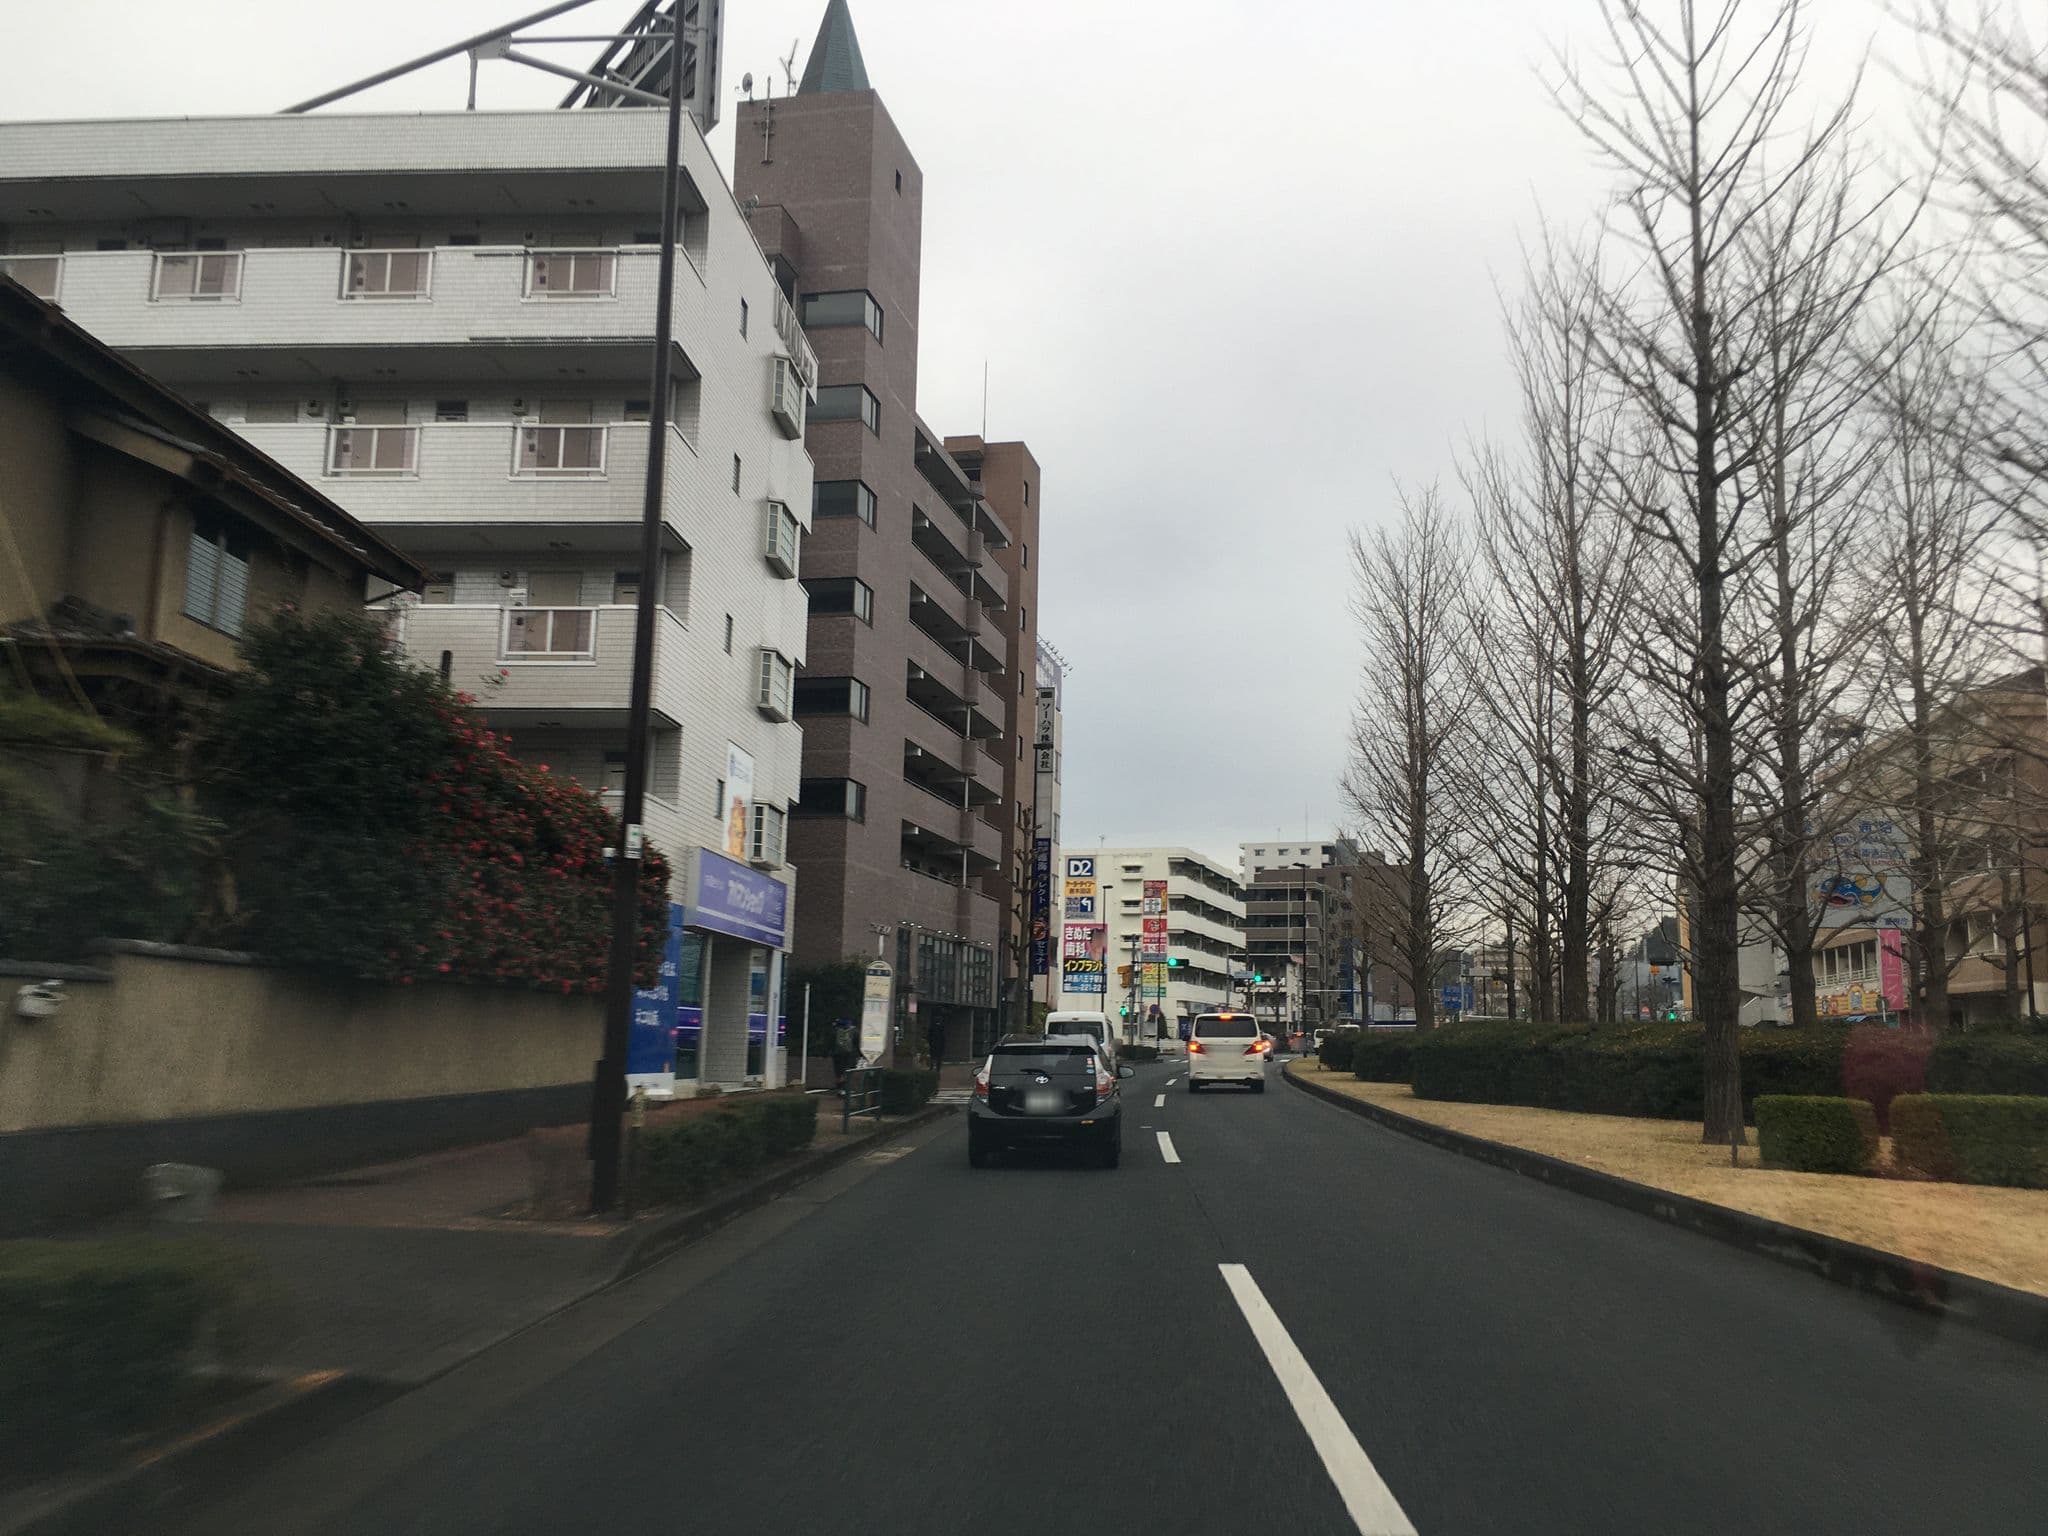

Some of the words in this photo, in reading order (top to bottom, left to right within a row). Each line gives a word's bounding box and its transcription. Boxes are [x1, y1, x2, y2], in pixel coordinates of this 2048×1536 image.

[1069, 860, 1092, 876] D2
[1065, 927, 1092, 940] きぬた
[1065, 942, 1086, 958] 歯科
[1064, 959, 1103, 972] インプラント
